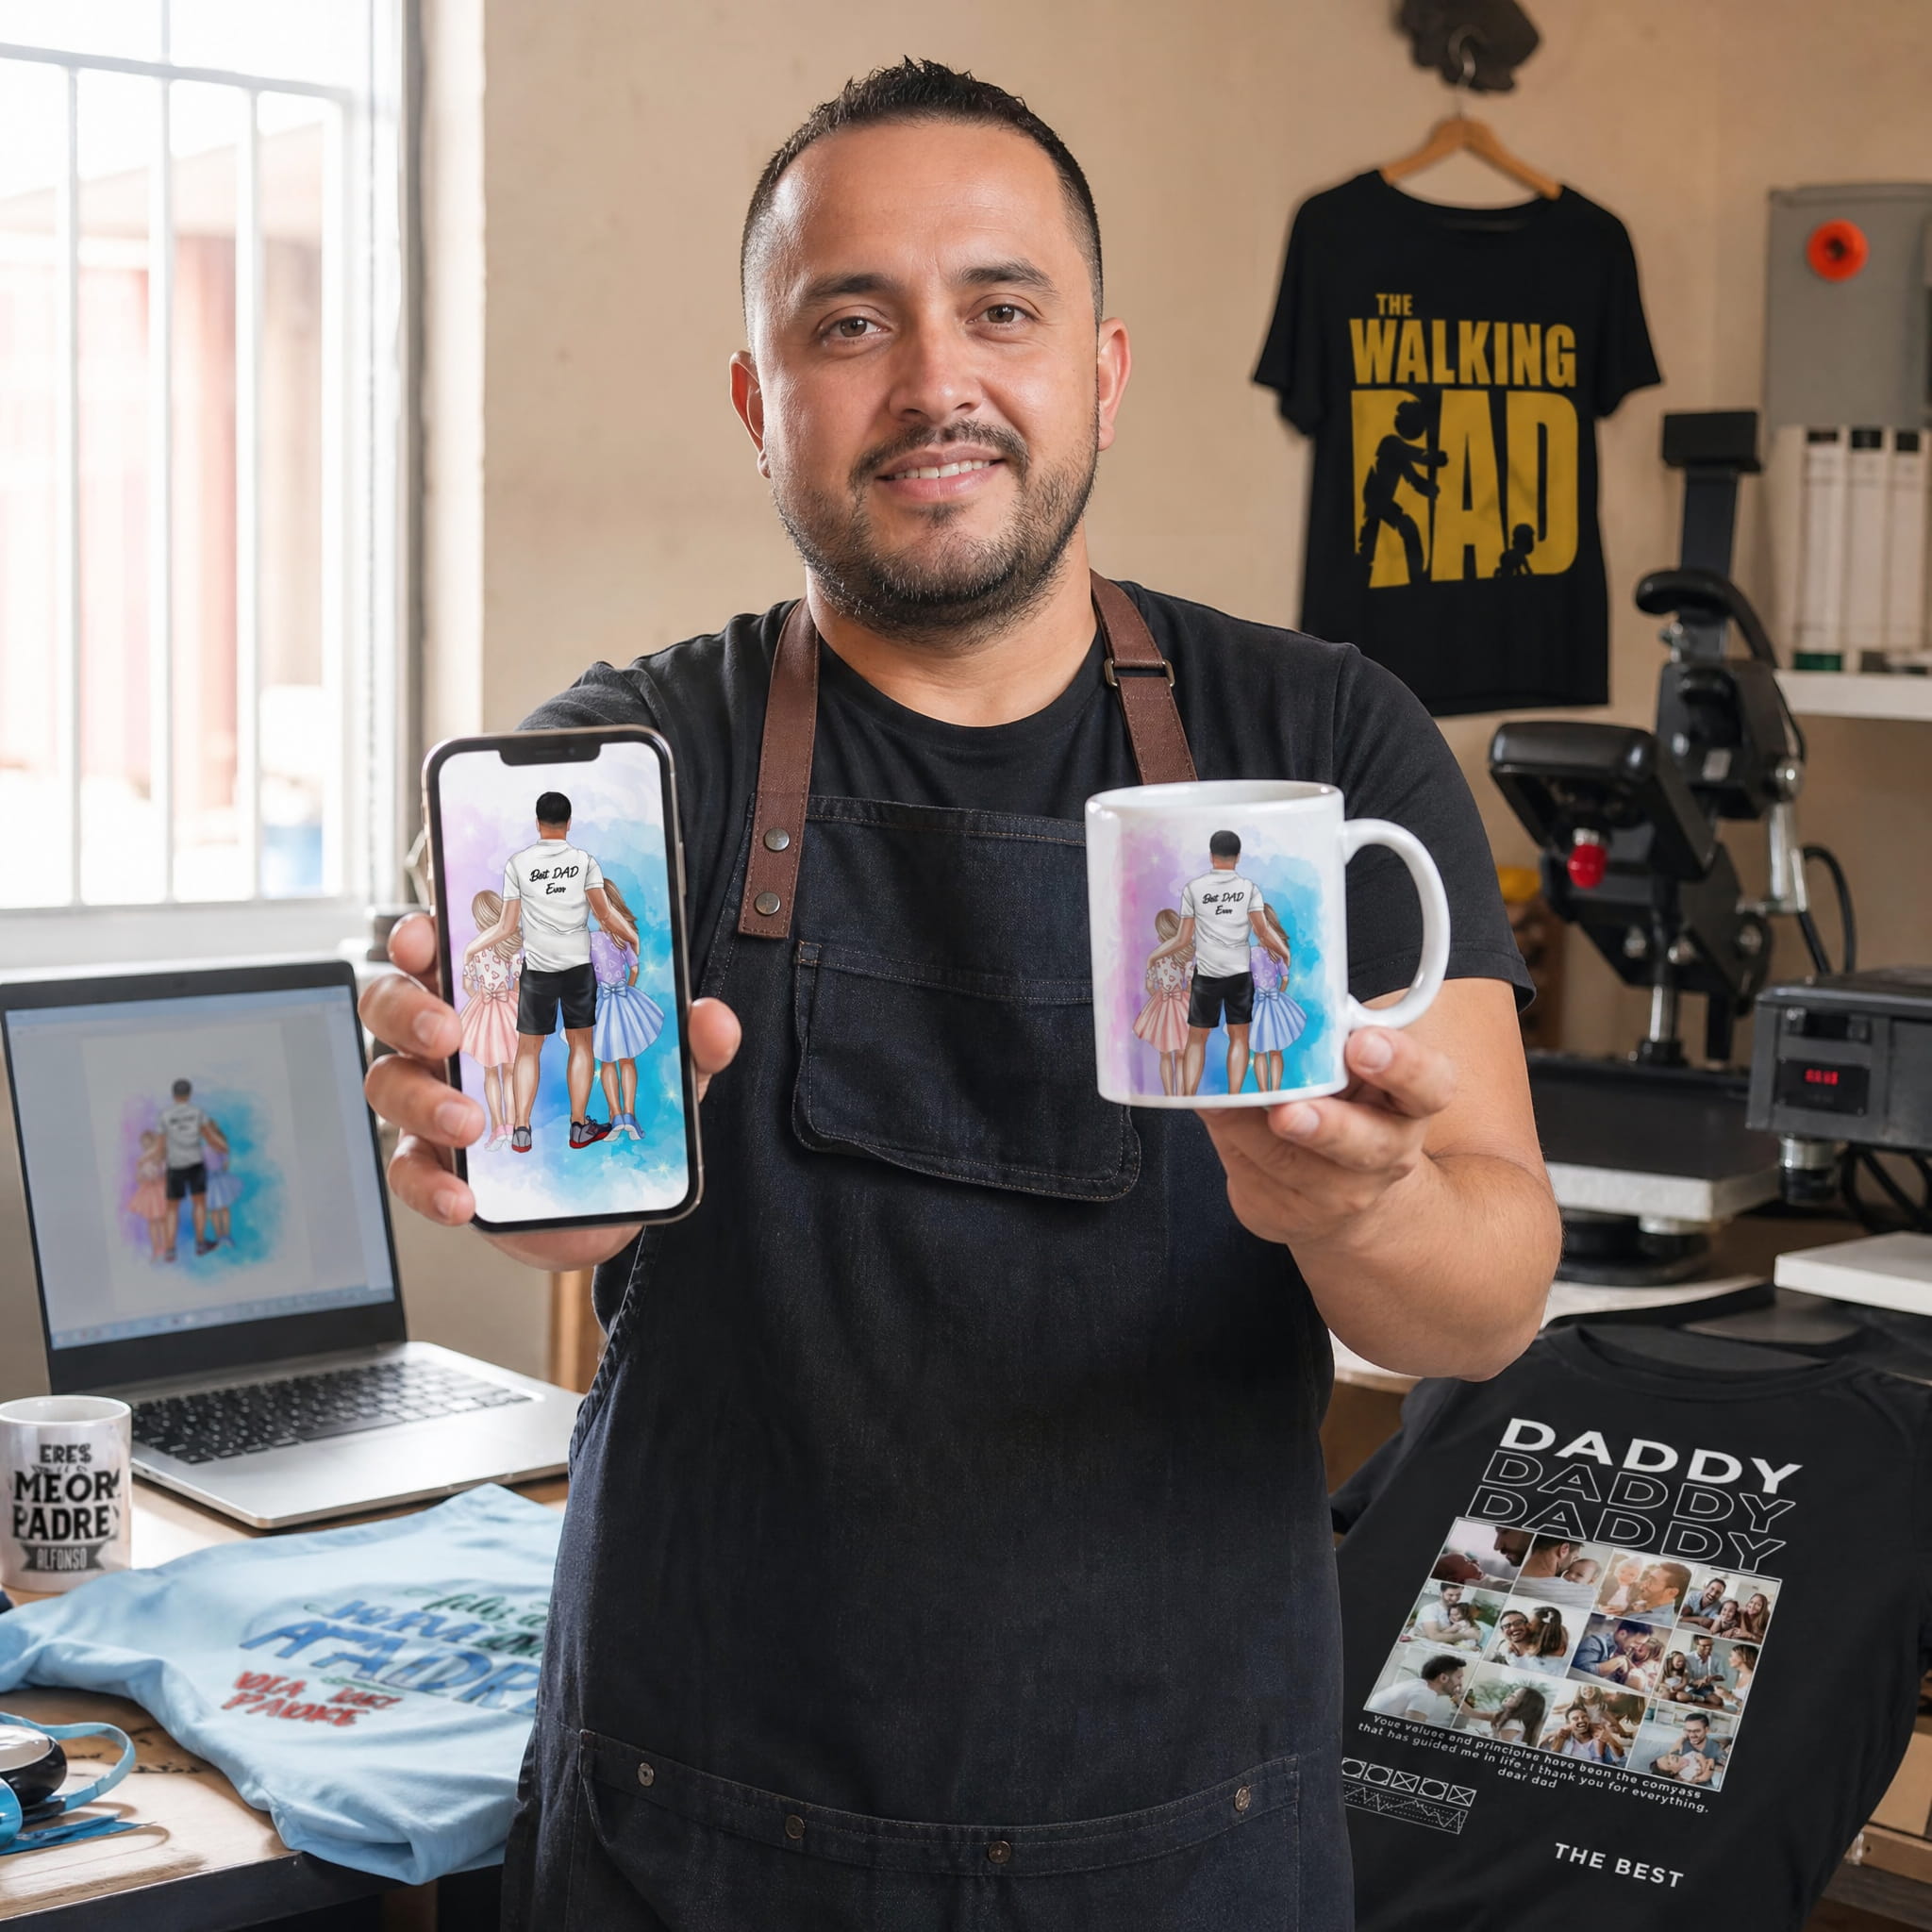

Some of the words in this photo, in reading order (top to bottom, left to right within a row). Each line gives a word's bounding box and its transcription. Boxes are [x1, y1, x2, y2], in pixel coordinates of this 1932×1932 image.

[1375, 293, 1413, 317] THE
[1349, 318, 1576, 388] WALKING
[1351, 389, 1579, 589] DAD
[552, 866, 579, 879] DAD
[1221, 891, 1244, 903] DAD
[1499, 1418, 1803, 1494] DADDY
[1482, 1450, 1796, 1533] DADDY
[1465, 1485, 1787, 1573] DADDY
[37, 1547, 88, 1570] ALFONSO
[1357, 1723, 1384, 1736] that
[1388, 1729, 1409, 1741] has
[1412, 1737, 1457, 1753] guided
[1484, 1752, 1495, 1762] in
[1539, 1765, 1576, 1781] thank
[1578, 1776, 1605, 1788] you
[1608, 1781, 1628, 1793] for
[1616, 1772, 1638, 1784] the
[1556, 1842, 1606, 1869] THE
[1615, 1857, 1684, 1888] BEST
